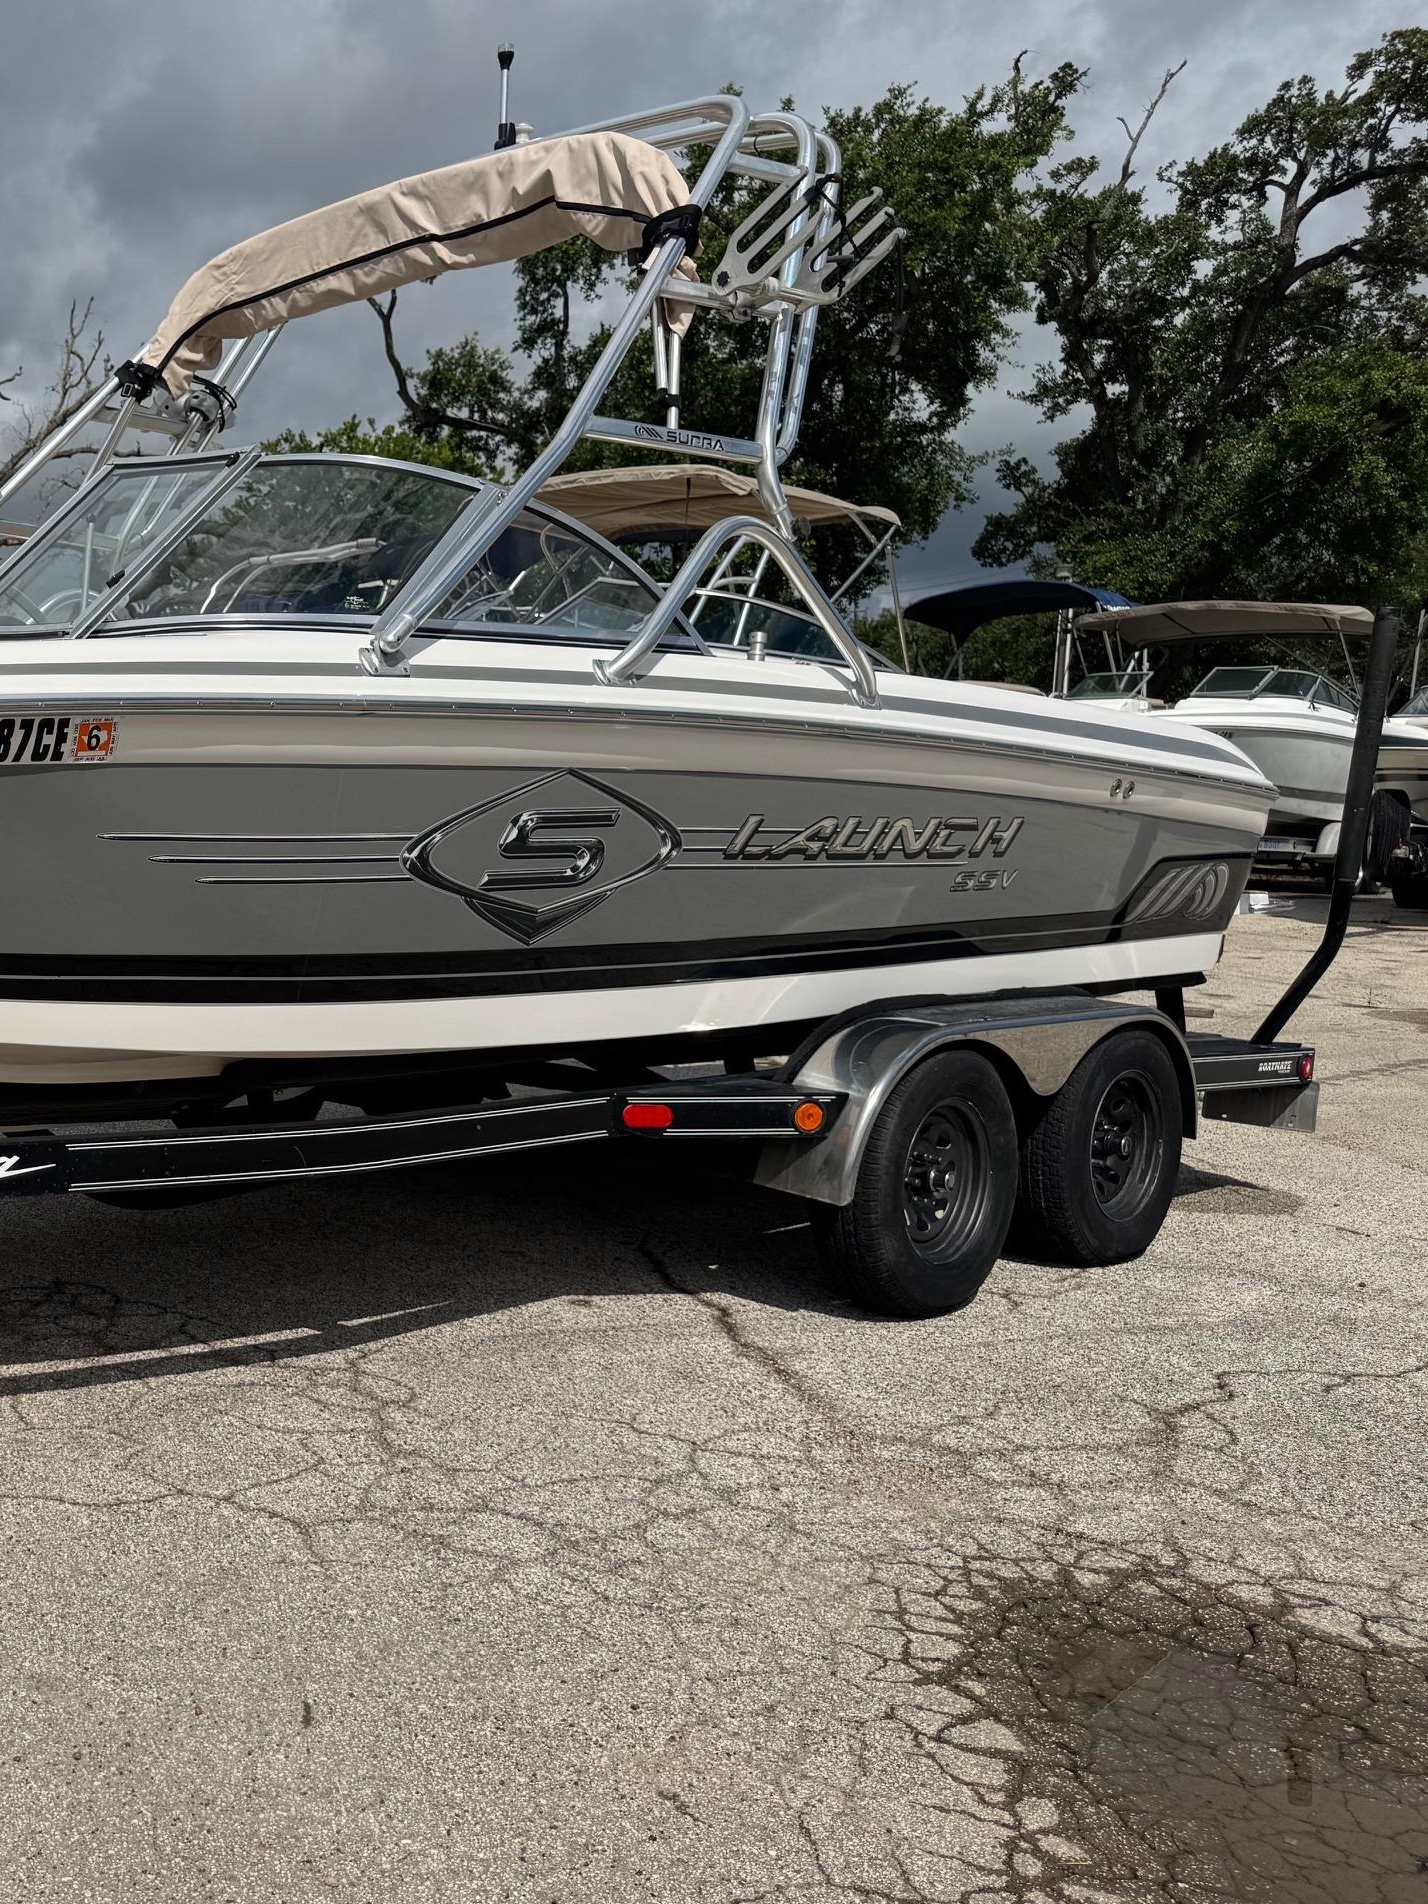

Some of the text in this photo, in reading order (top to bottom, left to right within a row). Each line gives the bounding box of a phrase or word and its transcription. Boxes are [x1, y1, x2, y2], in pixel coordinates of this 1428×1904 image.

[666, 430, 724, 451] SUPRA
[87, 724, 102, 751] 6
[723, 813, 1025, 860] LAUNCH
[949, 869, 1019, 892] SSV
